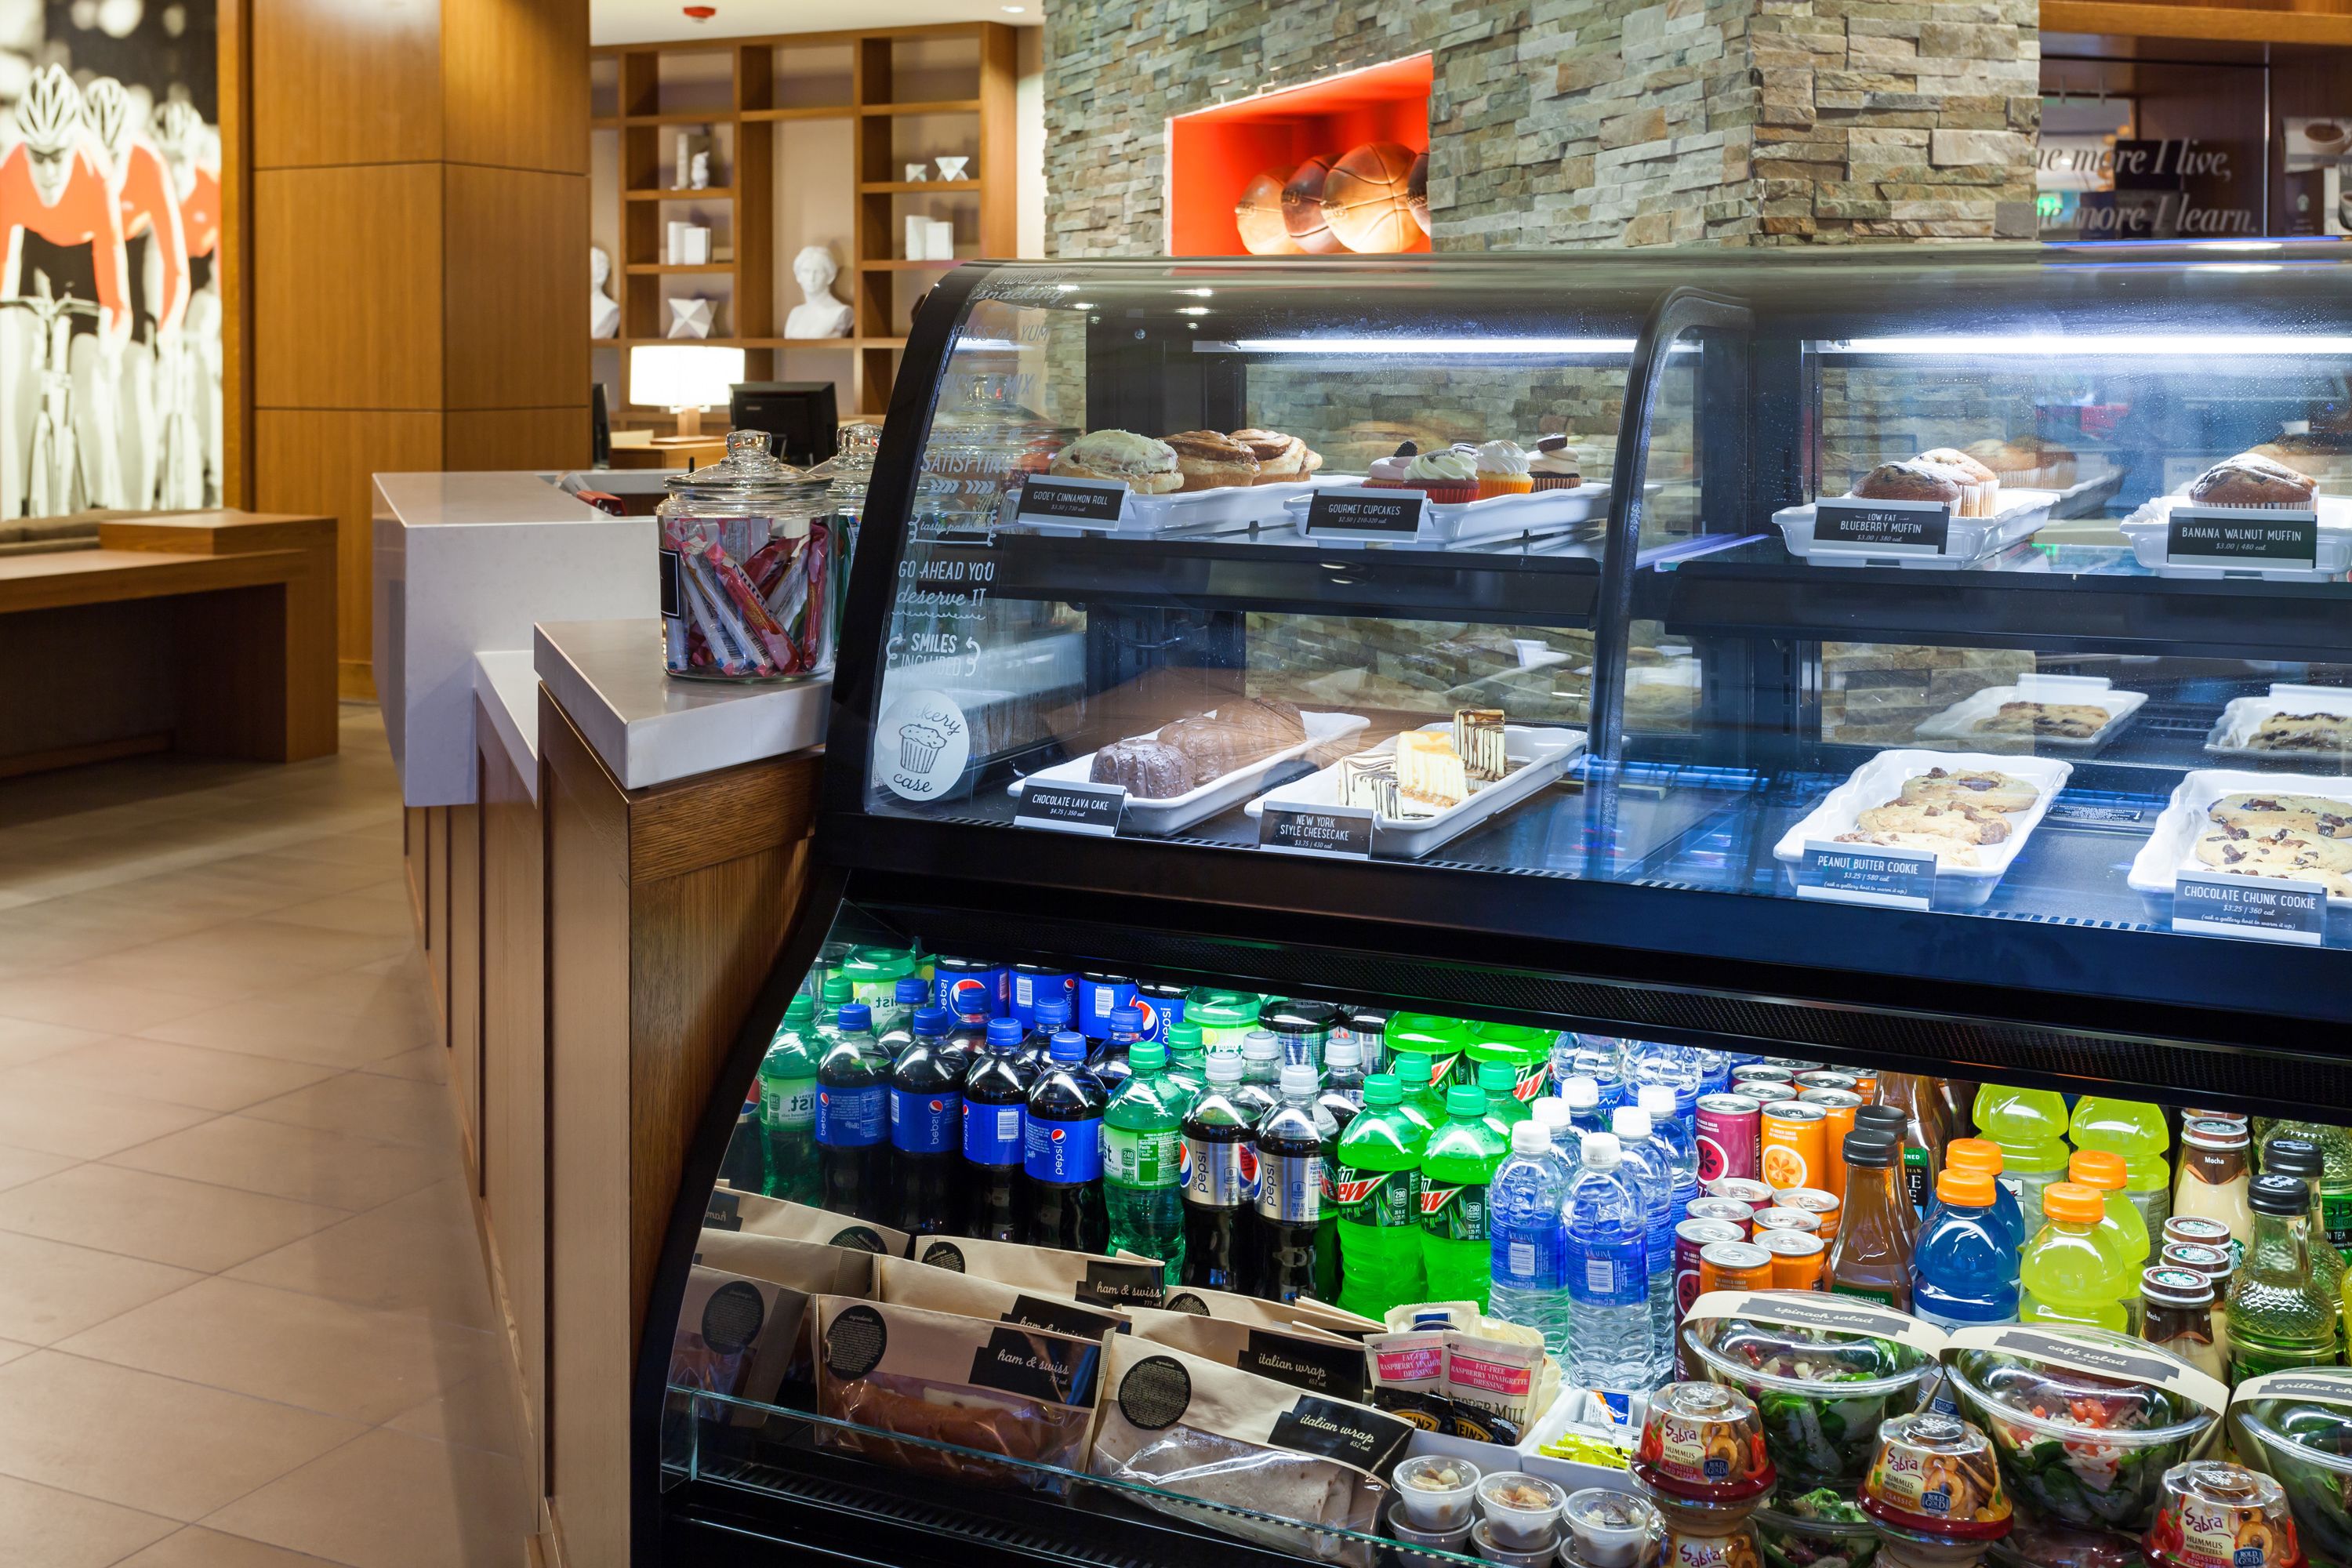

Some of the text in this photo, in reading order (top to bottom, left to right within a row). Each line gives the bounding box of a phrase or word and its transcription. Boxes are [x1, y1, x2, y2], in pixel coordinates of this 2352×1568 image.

[2071, 137, 2233, 182] more I live,
[2071, 193, 2258, 234] more I learn.
[972, 286, 1065, 304] snacking
[1020, 325, 1049, 341] YUM
[920, 451, 1014, 474] SATISFYING
[1033, 491, 1108, 506] GOOEY CINNAMON ROLL
[1328, 503, 1401, 515] GOURMET CUPCAKES
[1867, 513, 1882, 521] LOW
[1840, 520, 1922, 534] BLUEBERRY MUFFIN
[2182, 527, 2302, 542] BANANA WALNUT MUFFIN
[898, 560, 995, 582] GO AHEAD YOU
[896, 584, 986, 608] deserve IT
[911, 632, 958, 653] SMILES
[893, 772, 933, 793] case
[1032, 793, 1109, 811] CHOCOLATE LAVA CAKE
[1296, 815, 1335, 828] NEW YORK
[1280, 824, 1349, 841] STYLE CHEESECAKE
[1817, 855, 1919, 875] PEANUT BUTTER COOKIE
[2184, 885, 2316, 909] CHOCOLATE CHUNK COOKIE
[2223, 904, 2242, 913] $3.25
[2205, 1156, 2225, 1165] Mocha
[1196, 1151, 1209, 1193] pepsi
[1265, 1163, 1277, 1207] pepsi
[1338, 1177, 1384, 1202] ew
[2334, 1231, 2347, 1240] TEA
[1097, 1280, 1162, 1298] ham & swiss
[1774, 1305, 1829, 1320] spinach
[1833, 1312, 1875, 1325] salad
[2146, 1310, 2161, 1322] Mocha
[997, 1348, 1069, 1375] ham & swiss
[1402, 1351, 1431, 1361] FAT-FREE
[2047, 1344, 2081, 1356] café
[2082, 1352, 2128, 1367] salad
[1258, 1353, 1327, 1380] italian wrap
[1380, 1362, 1414, 1370] RASPBERRY
[1403, 1368, 1434, 1378] DRESSING
[1475, 1363, 1505, 1374] FAT-FREE
[1450, 1365, 1528, 1386] RASPBERRY VINAIGRETTE
[1473, 1378, 1504, 1391] DRESSING
[2275, 1382, 2332, 1391] grilled
[1300, 1414, 1374, 1444] italian wrap
[1664, 1419, 1697, 1444] Sabra
[1349, 1440, 1361, 1449] 652
[1664, 1444, 1696, 1459] HUMMUS
[1671, 1454, 1695, 1465] PRETZELS
[1887, 1446, 1919, 1472] Sabra
[1668, 1461, 1694, 1474] ROASTED
[1885, 1472, 1914, 1489] HUMMUS
[1890, 1482, 1913, 1494] PRETZELS
[1885, 1490, 1914, 1507] CLASSIC
[1925, 1499, 1946, 1509] GOLD
[1927, 1494, 1945, 1502] ROLD
[2183, 1507, 2224, 1534] Sabra
[2186, 1534, 2223, 1549] HUMMUS
[2194, 1544, 2223, 1555] PRETZELS
[1679, 1543, 1721, 1568] Sabra
[2190, 1552, 2223, 1565] ROASTED
[2238, 1556, 2259, 1566] GOLD
